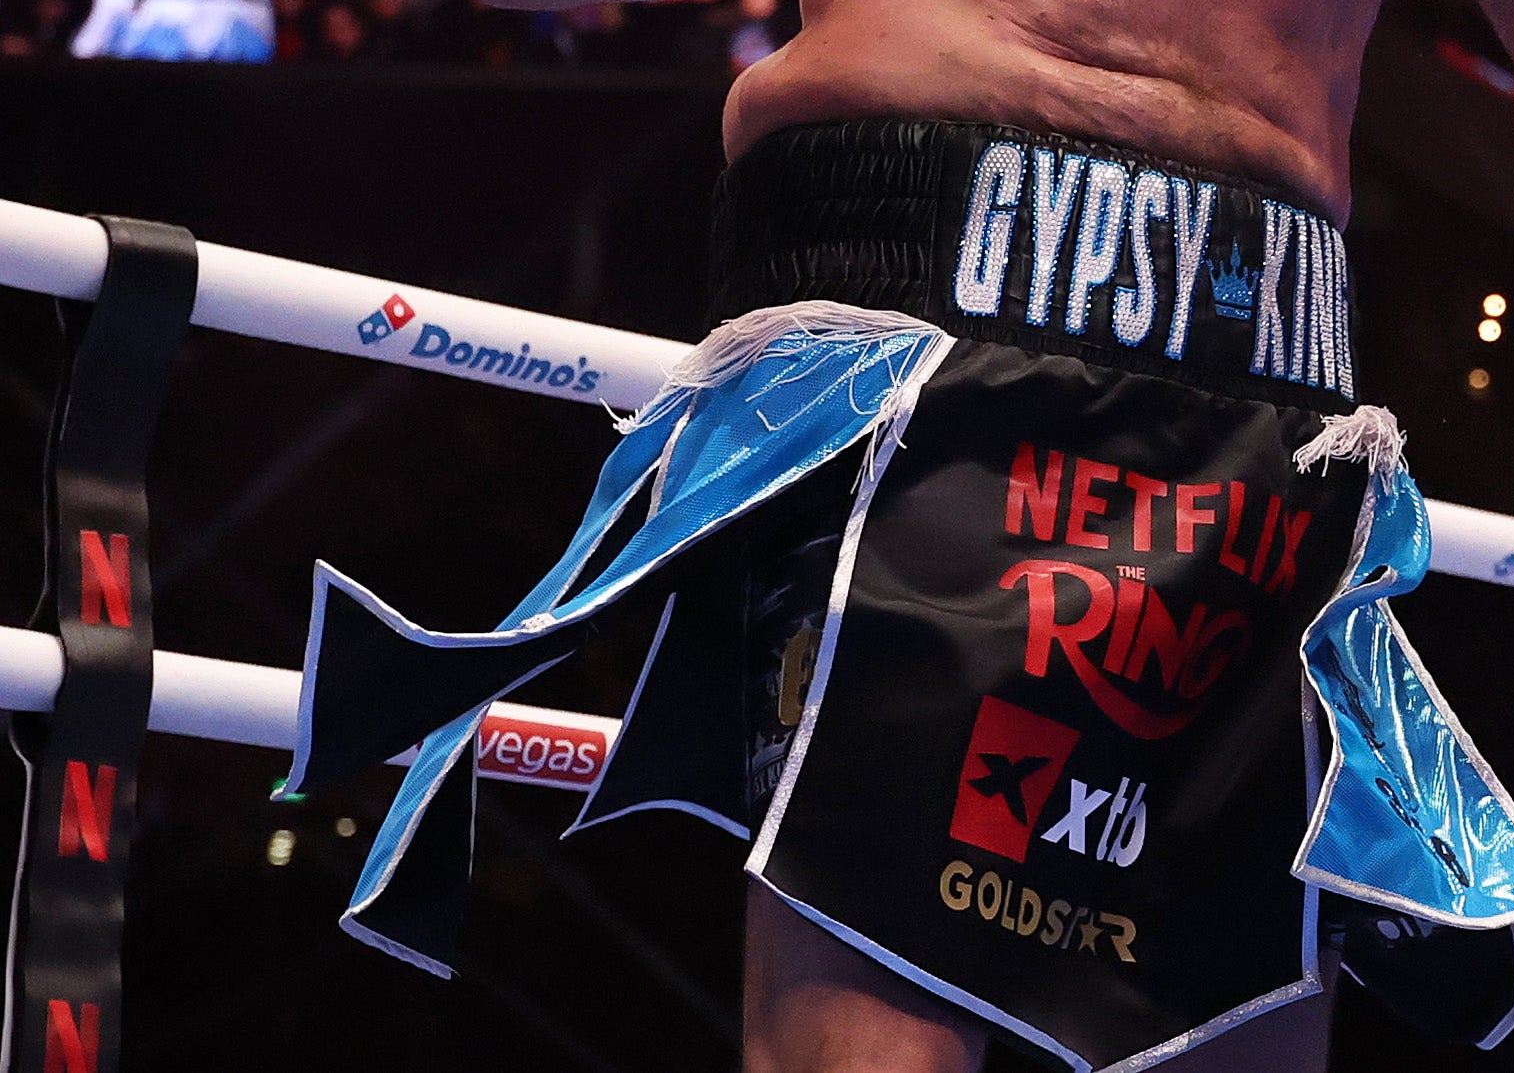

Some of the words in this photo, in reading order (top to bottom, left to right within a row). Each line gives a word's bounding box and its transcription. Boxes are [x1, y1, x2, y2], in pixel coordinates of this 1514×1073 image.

[953, 139, 1218, 361] GYPSY
[409, 323, 602, 394] Domino's
[1004, 441, 1312, 594] NETFLIX
[1116, 565, 1146, 582] THE
[997, 558, 1253, 741] RING
[477, 729, 599, 776] vegas
[1040, 776, 1147, 868] xtb
